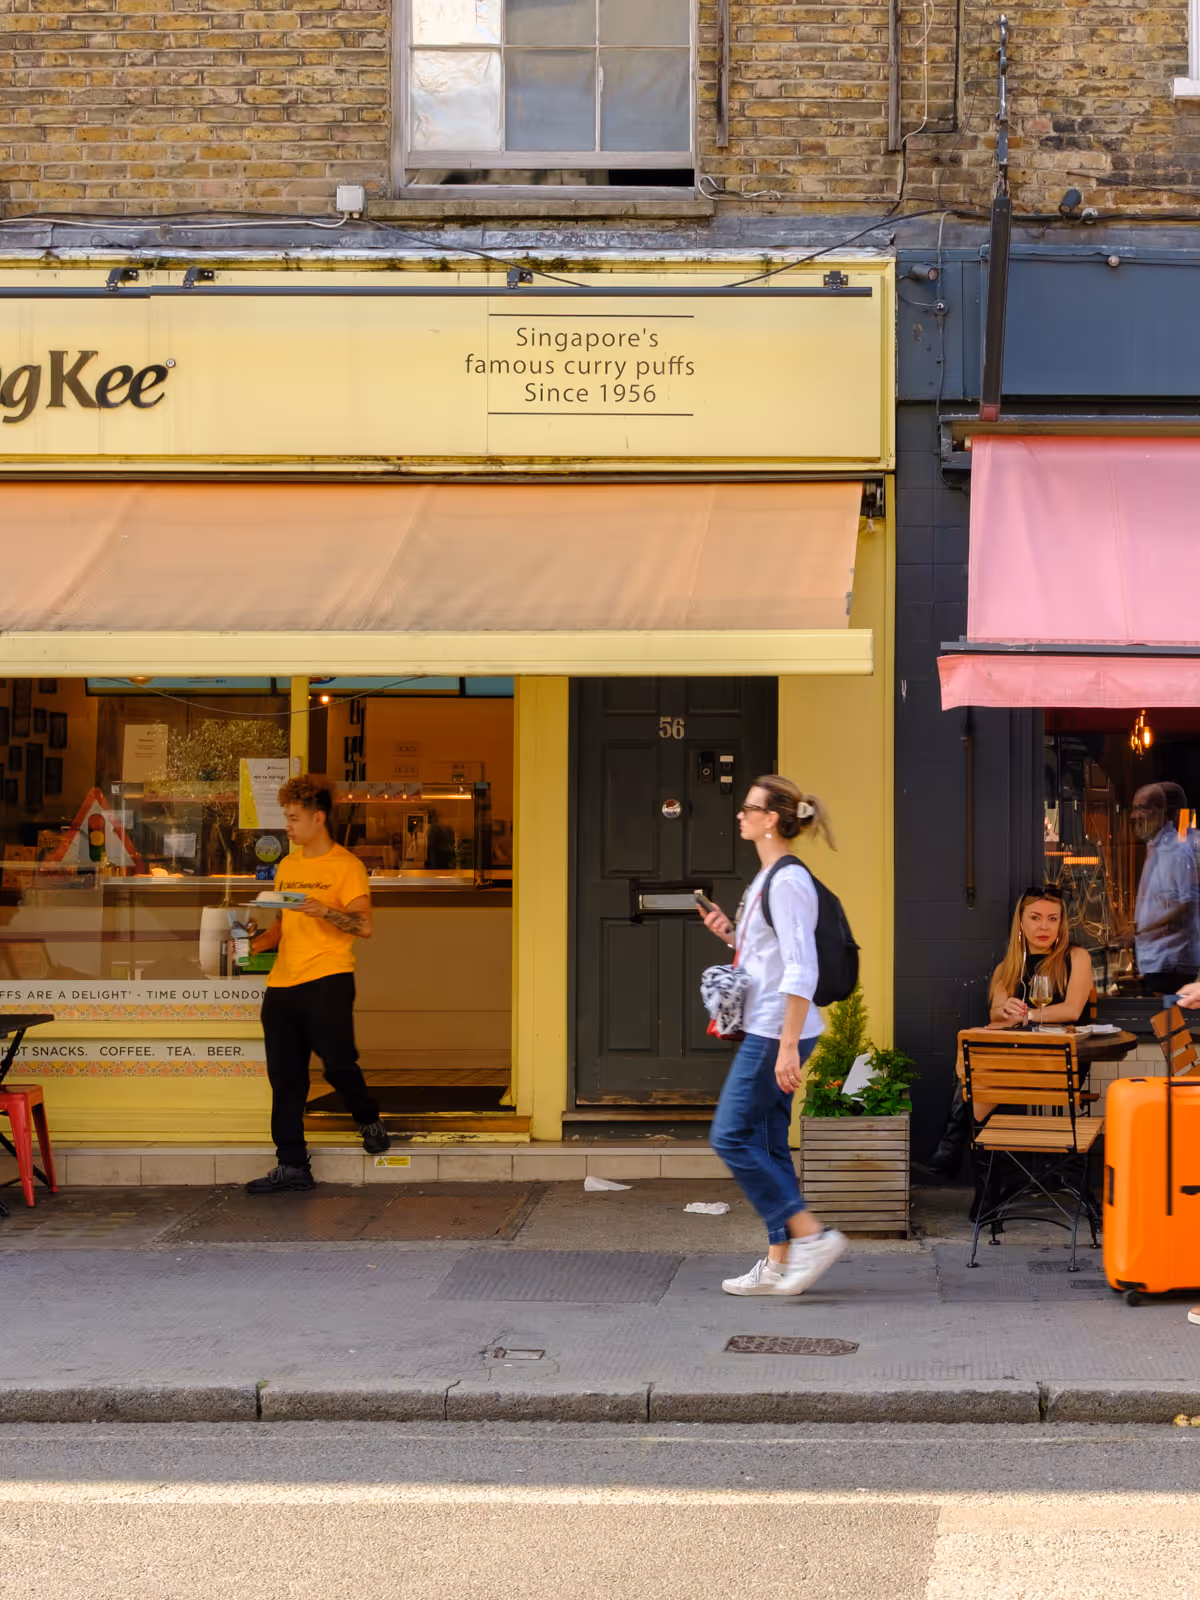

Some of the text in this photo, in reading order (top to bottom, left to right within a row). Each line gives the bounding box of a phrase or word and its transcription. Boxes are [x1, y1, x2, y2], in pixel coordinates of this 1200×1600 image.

[515, 327, 659, 352] Singapore's
[465, 353, 695, 380] famous curry puffs
[524, 382, 657, 403] Since 1956
[658, 716, 685, 740] 56
[27, 990, 53, 1000] ARE
[58, 990, 66, 1000] A
[147, 990, 177, 1000] TIME
[182, 990, 209, 1000] OUT
[32, 1046, 88, 1057] SNACKS.
[99, 1046, 155, 1057] COFFEE.
[166, 1046, 195, 1057] TEA.
[207, 1046, 245, 1057] BEER.
